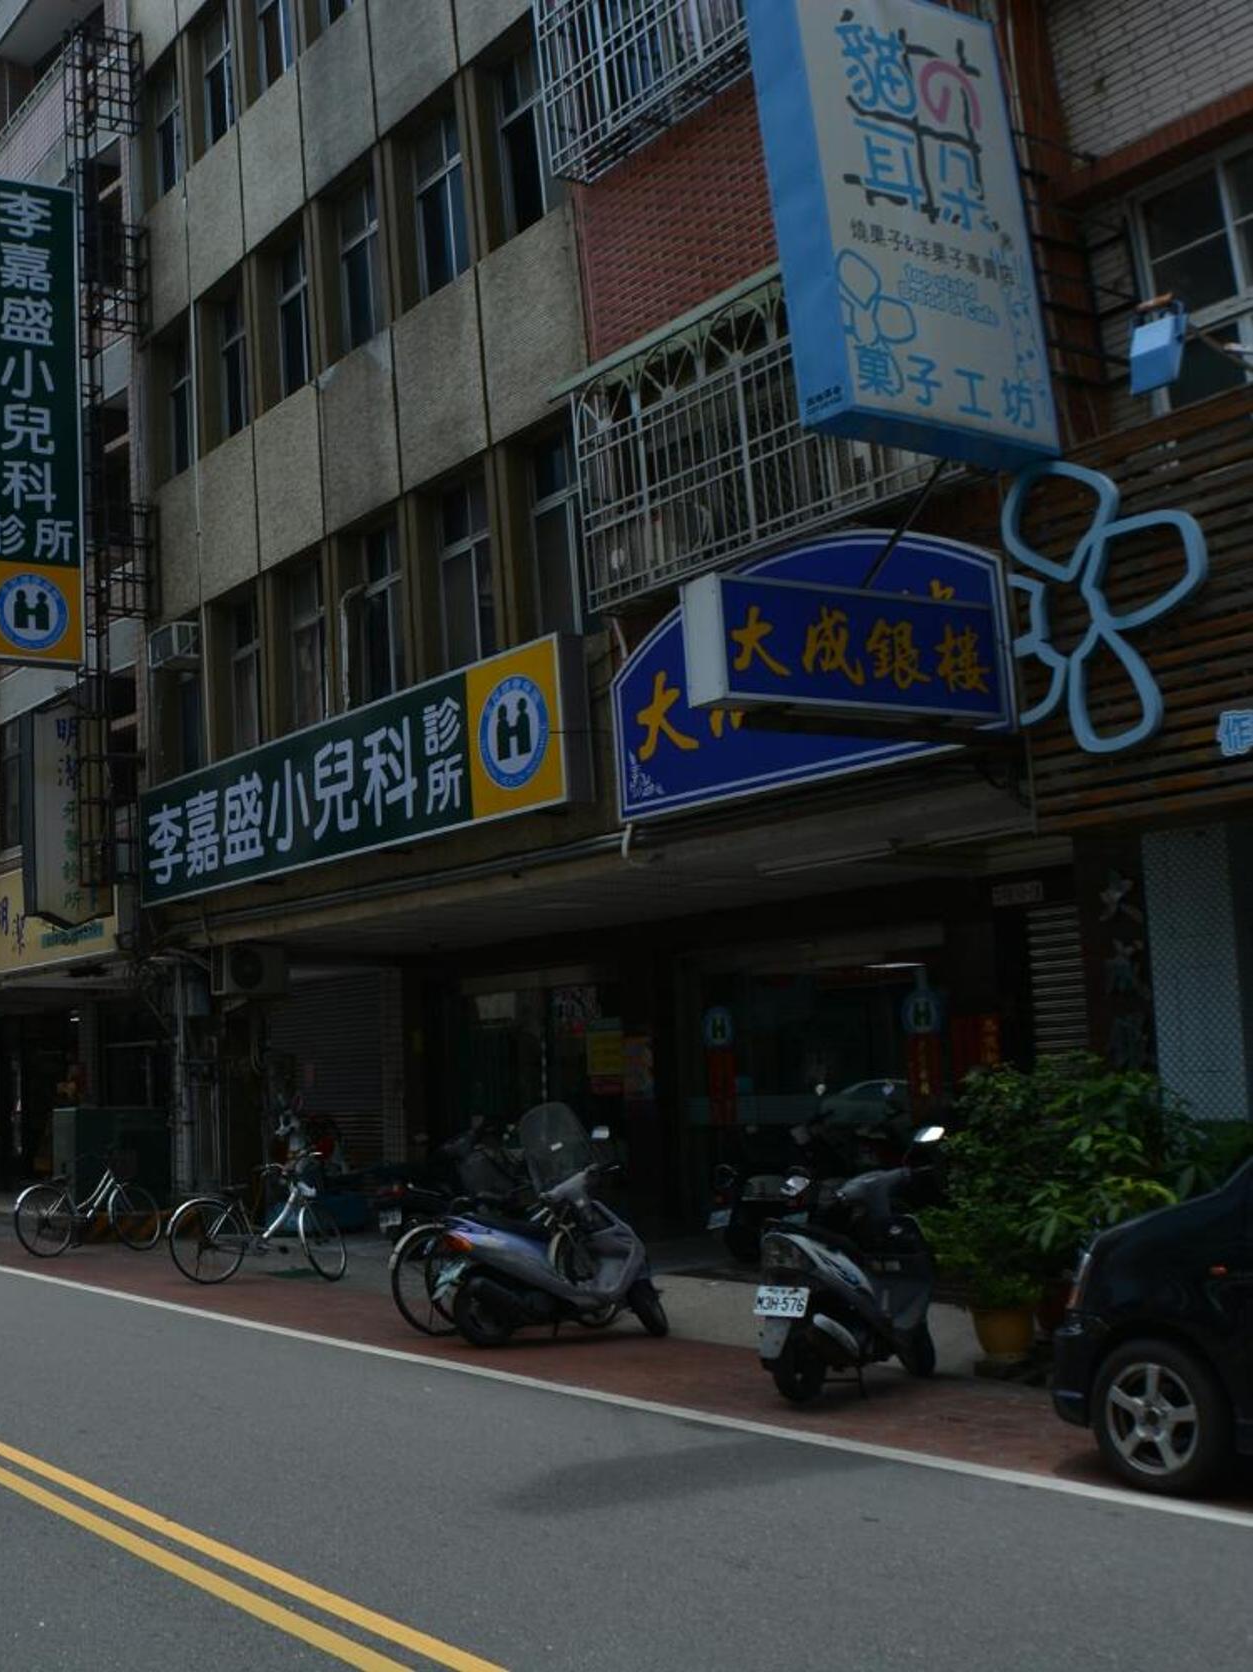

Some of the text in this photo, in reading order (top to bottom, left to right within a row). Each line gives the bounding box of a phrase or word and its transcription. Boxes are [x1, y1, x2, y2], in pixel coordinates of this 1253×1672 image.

[730, 606, 990, 694] 大成銀樓
[148, 716, 420, 886] 李嘉盛小兒科
[423, 696, 464, 816] 診所
